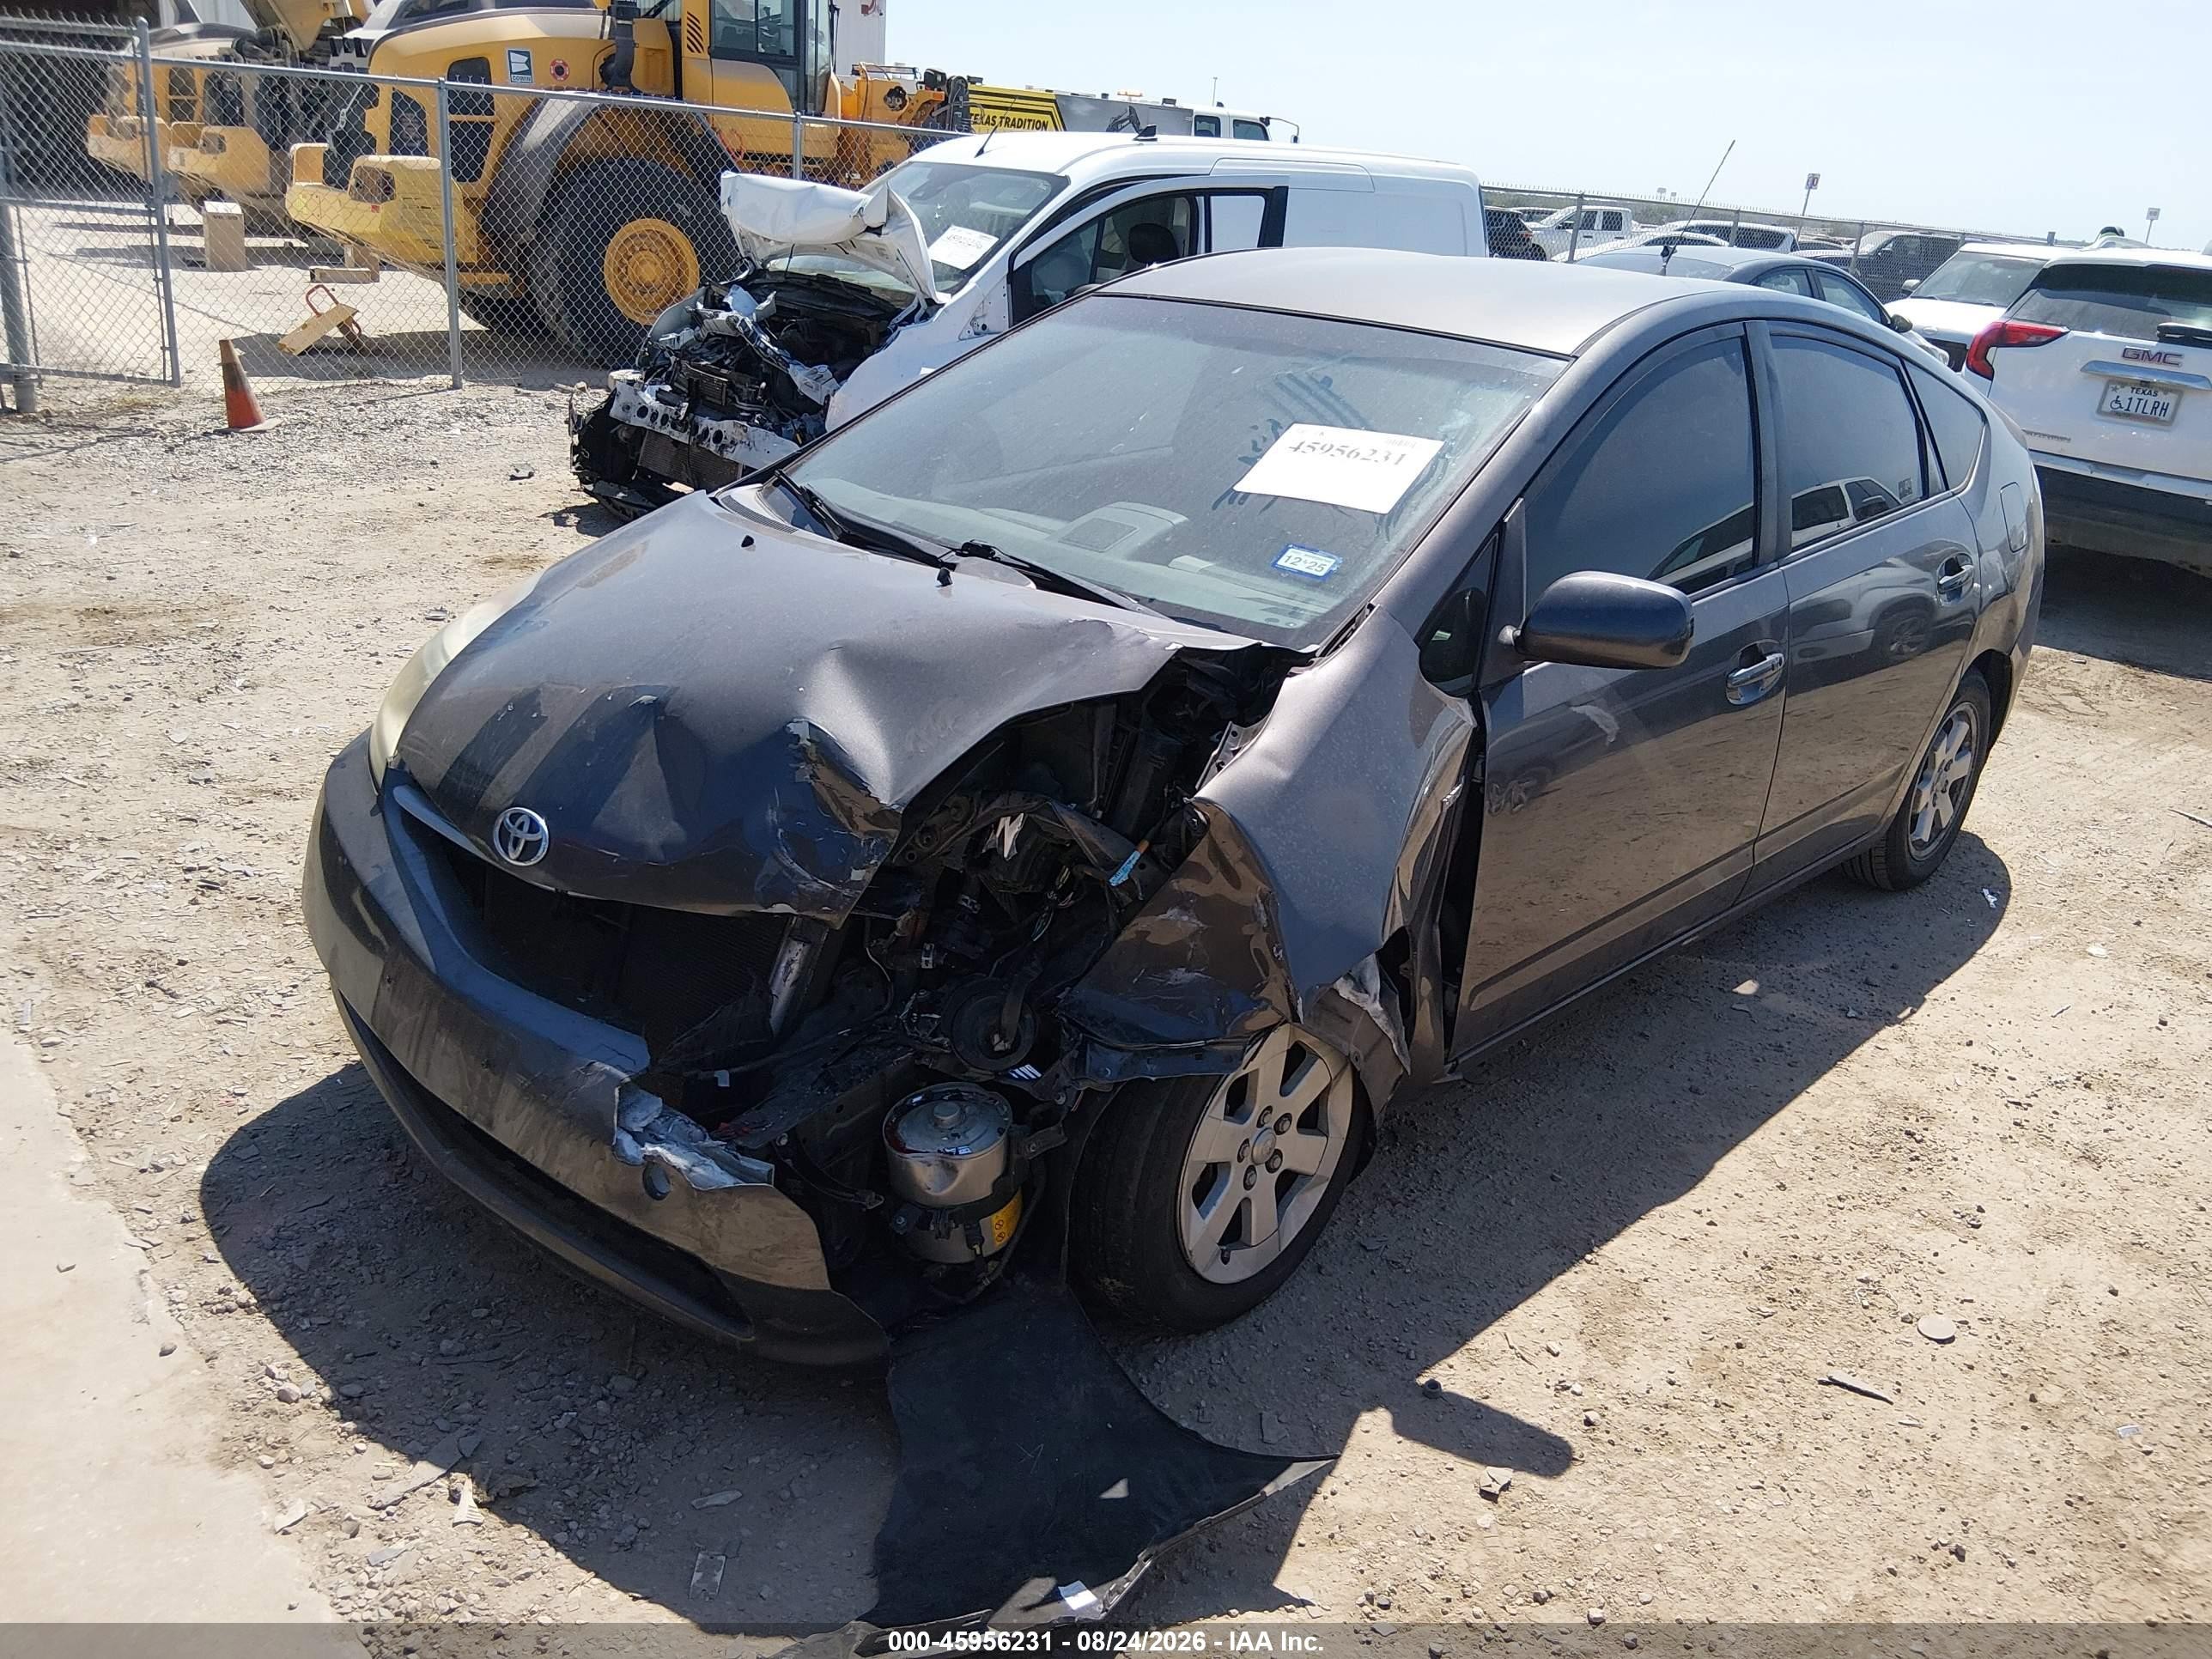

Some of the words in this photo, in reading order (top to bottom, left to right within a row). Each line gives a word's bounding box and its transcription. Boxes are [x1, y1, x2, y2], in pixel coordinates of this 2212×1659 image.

[969, 113, 997, 127] TEXAS
[998, 116, 1048, 131] TRADITION
[2122, 347, 2184, 368] GMC
[2130, 386, 2159, 397] TEXAS
[2124, 396, 2170, 417] 1TLRH
[1288, 441, 1407, 465] 45956231
